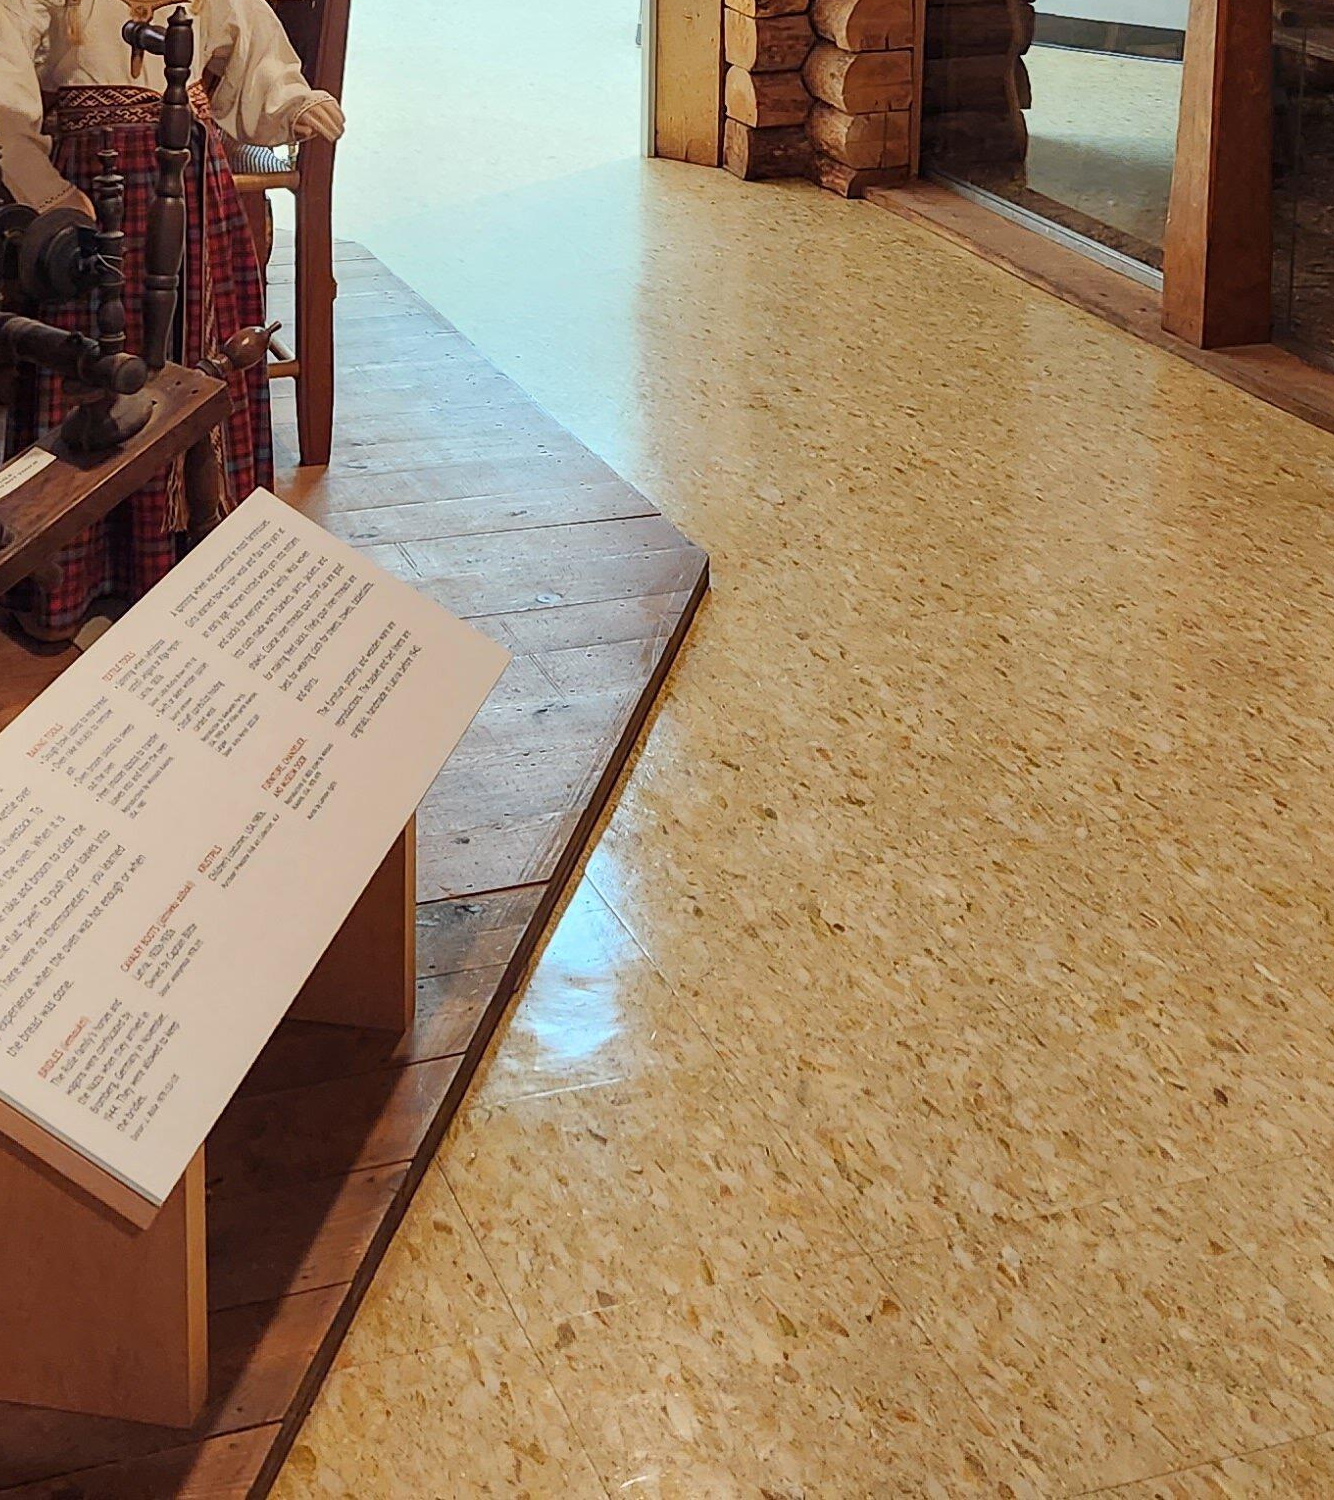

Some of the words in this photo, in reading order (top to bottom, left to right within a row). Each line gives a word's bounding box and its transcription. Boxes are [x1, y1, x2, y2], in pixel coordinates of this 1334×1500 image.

[101, 663, 122, 680] TEXTILE
[118, 651, 135, 665] TOOLS
[26, 738, 47, 757] BAKING
[43, 723, 63, 737] TOOLS
[15, 786, 30, 802] over
[2, 866, 18, 879] the
[30, 828, 51, 846] When
[2, 897, 19, 914] rake
[17, 882, 32, 898] and
[28, 861, 50, 884] broom
[57, 835, 74, 853] clear
[71, 824, 86, 836] the
[4, 929, 22, 943] flat
[48, 879, 65, 898] push
[64, 863, 79, 882] your
[75, 843, 98, 864] loaves
[93, 829, 110, 843] into
[19, 948, 37, 966] were
[43, 888, 88, 936] thermometers
[91, 870, 104, 885] you
[99, 844, 125, 870] learned
[33, 966, 52, 986] when
[49, 952, 64, 966] the
[62, 934, 79, 952] oven
[77, 919, 92, 933] was
[87, 905, 103, 919] hot
[100, 881, 123, 906] enough
[128, 854, 145, 872] when
[6, 1041, 22, 1056] the
[18, 1015, 42, 1041] bread
[40, 1000, 56, 1016] was
